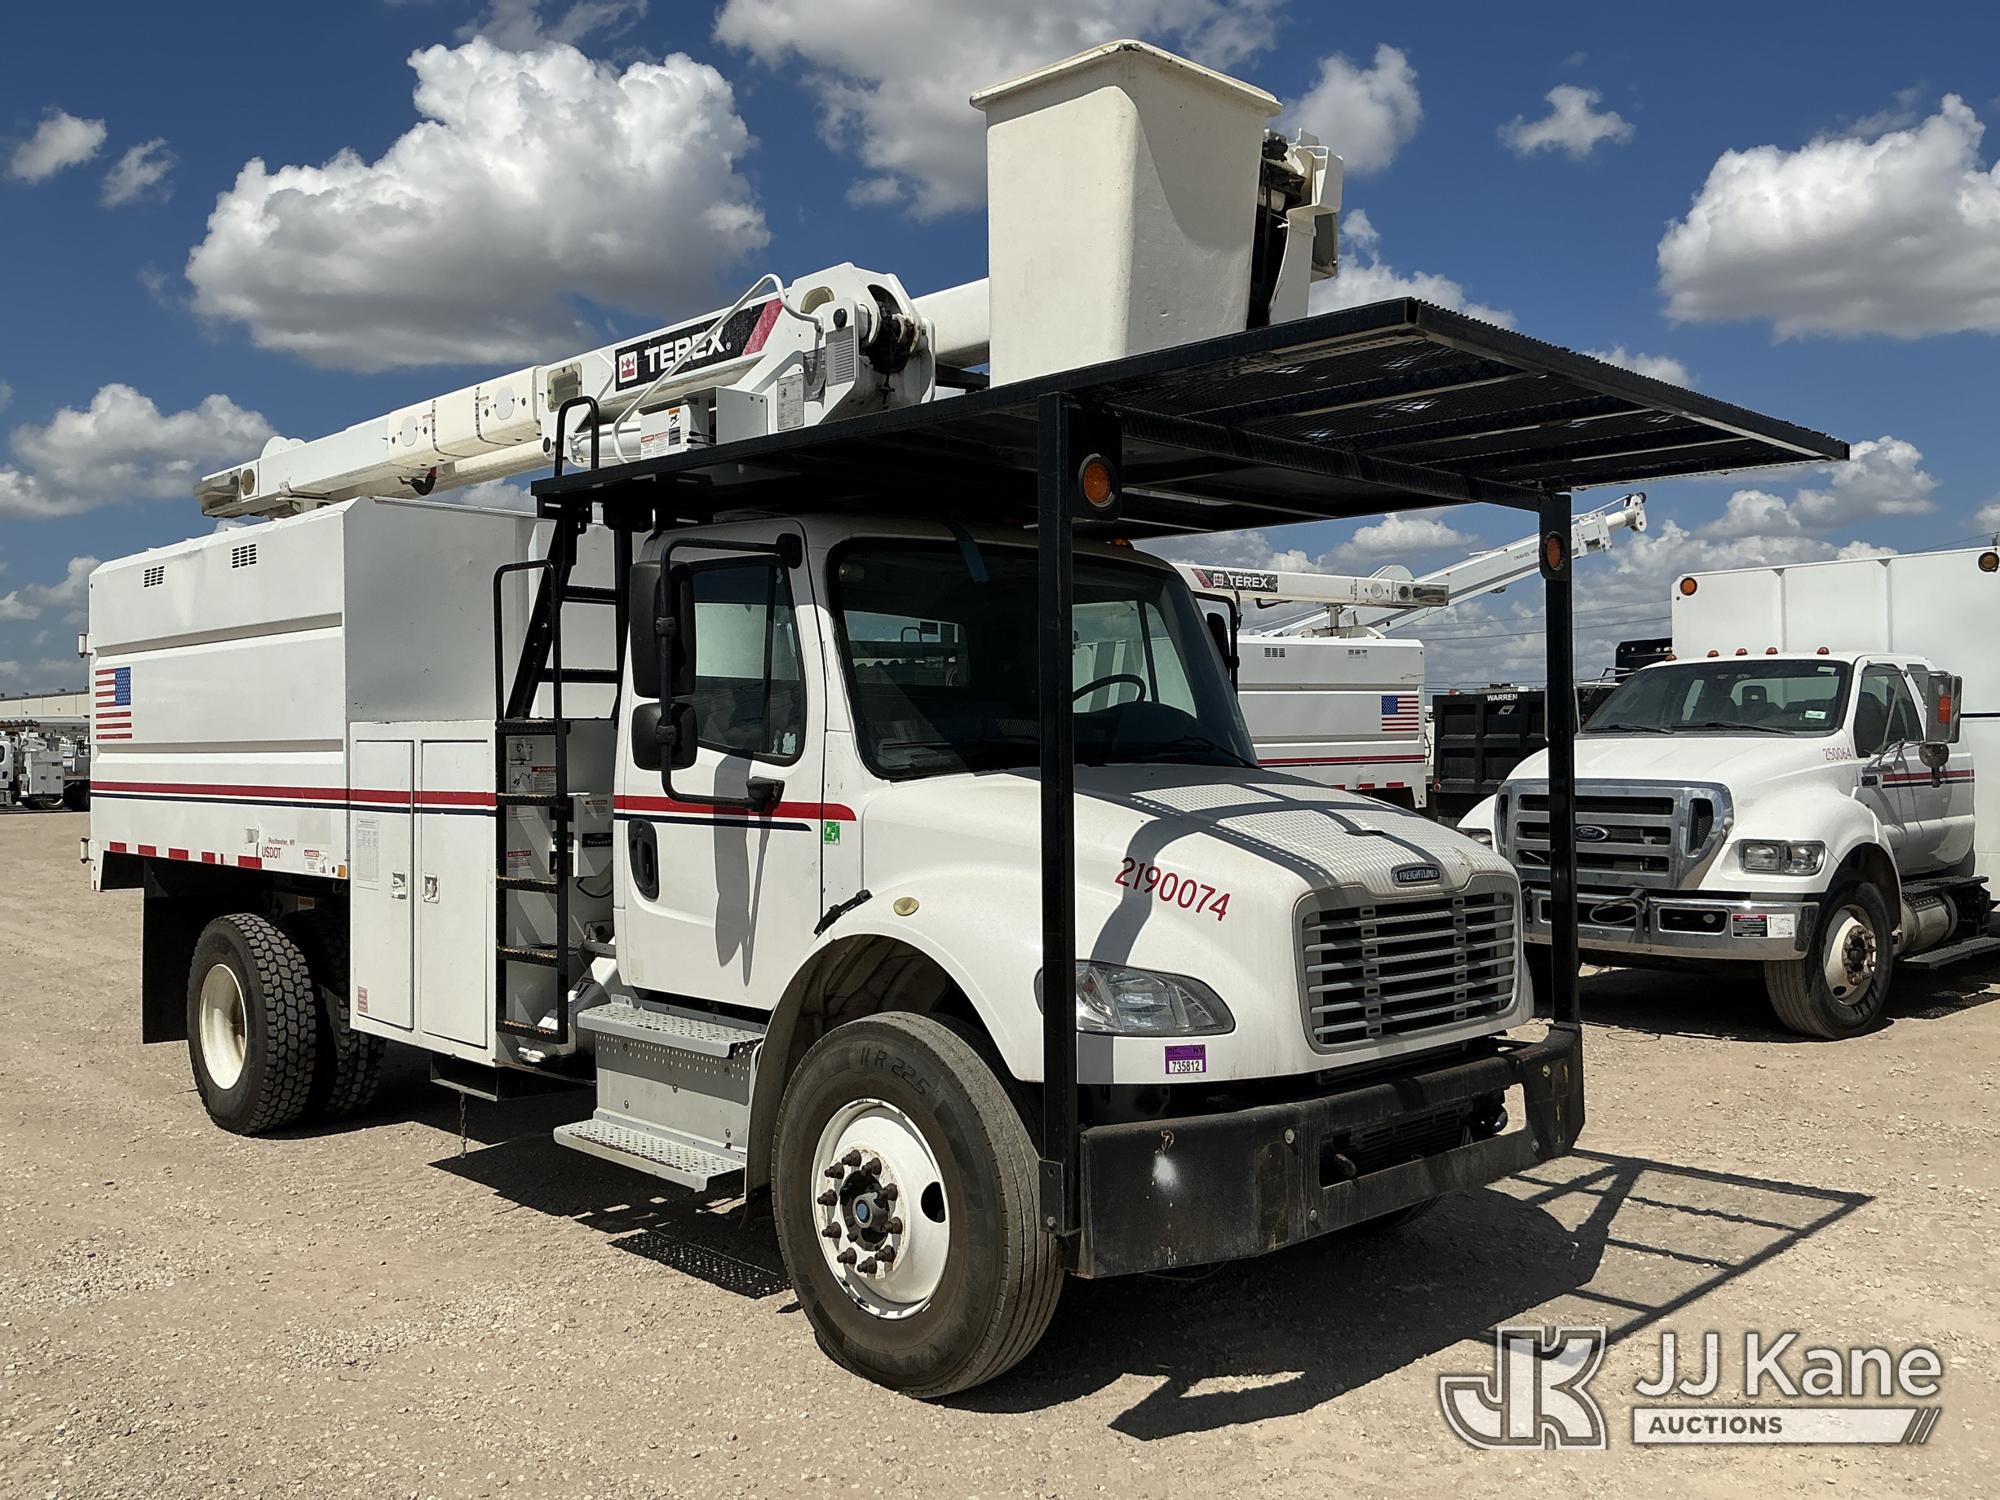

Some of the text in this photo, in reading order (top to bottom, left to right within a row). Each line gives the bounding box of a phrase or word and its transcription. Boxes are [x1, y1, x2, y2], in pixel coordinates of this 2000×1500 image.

[644, 326, 726, 373] TEREX
[1229, 575, 1268, 589] TEREX
[1487, 693, 1518, 702] WARREN
[1822, 747, 1852, 761] 250064
[262, 846, 281, 859] USDOT
[1399, 869, 1439, 881] FREIGHTLINER
[1114, 856, 1231, 922] 2190074
[1172, 1060, 1200, 1072] 735812
